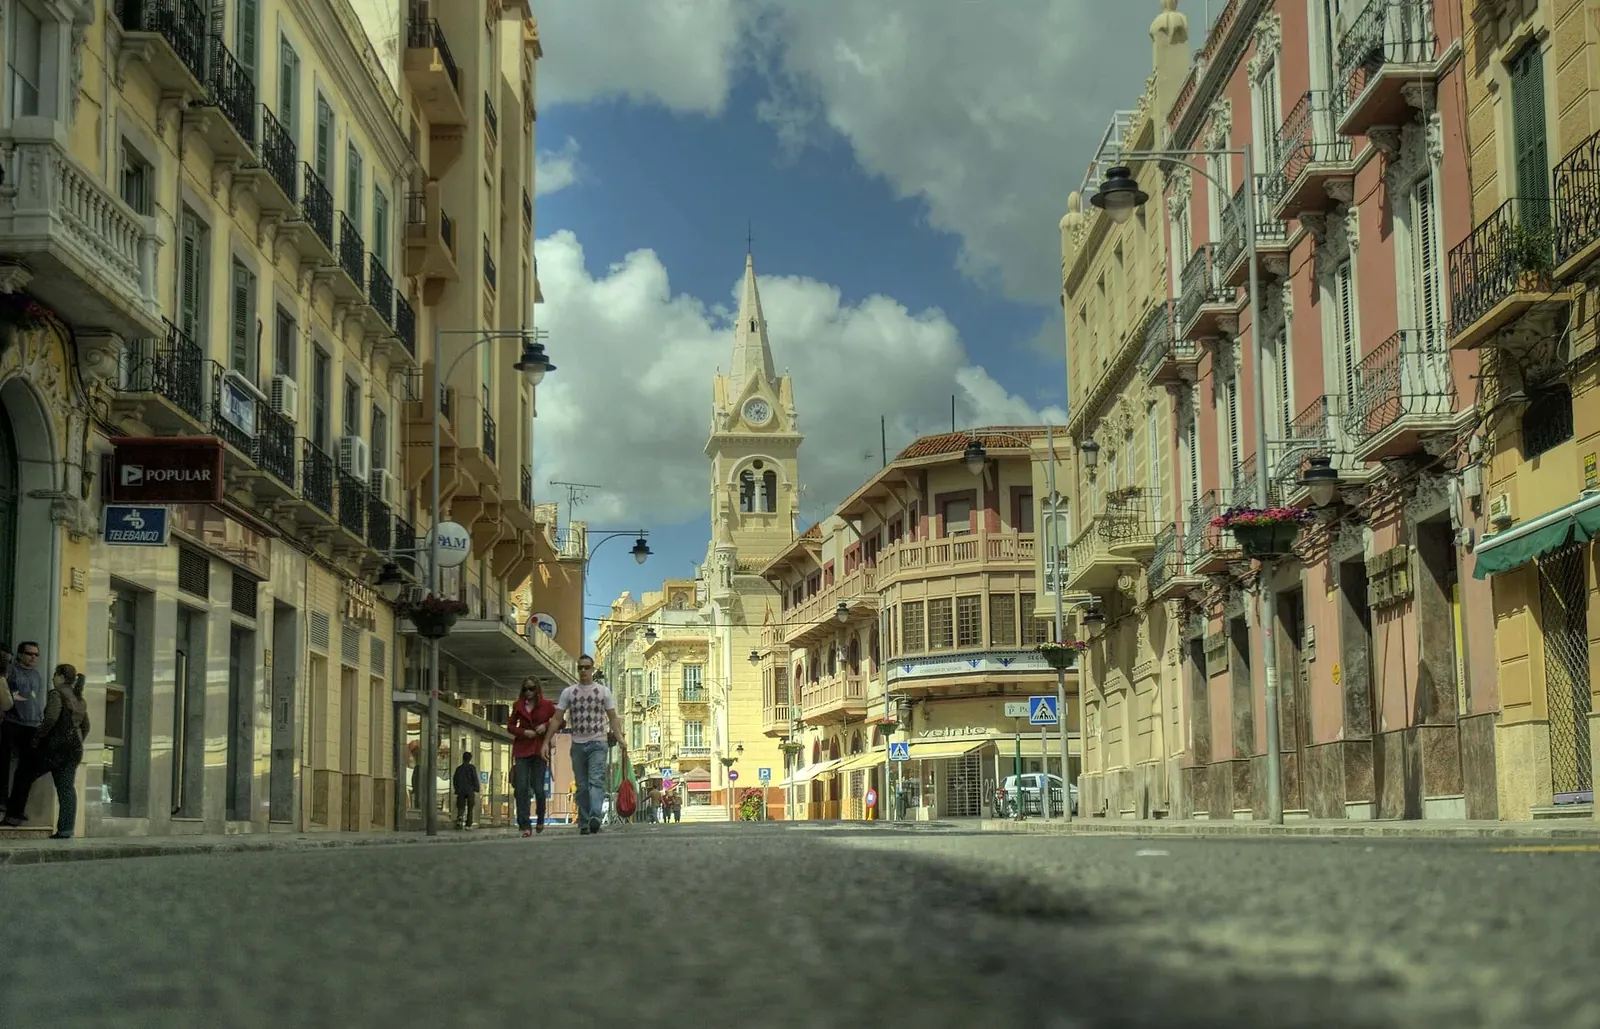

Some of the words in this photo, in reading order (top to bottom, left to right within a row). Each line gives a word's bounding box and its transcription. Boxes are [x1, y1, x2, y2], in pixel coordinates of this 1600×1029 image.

[146, 469, 211, 481] POPULAR
[109, 530, 159, 542] TELEBANCO
[761, 769, 769, 779] P
